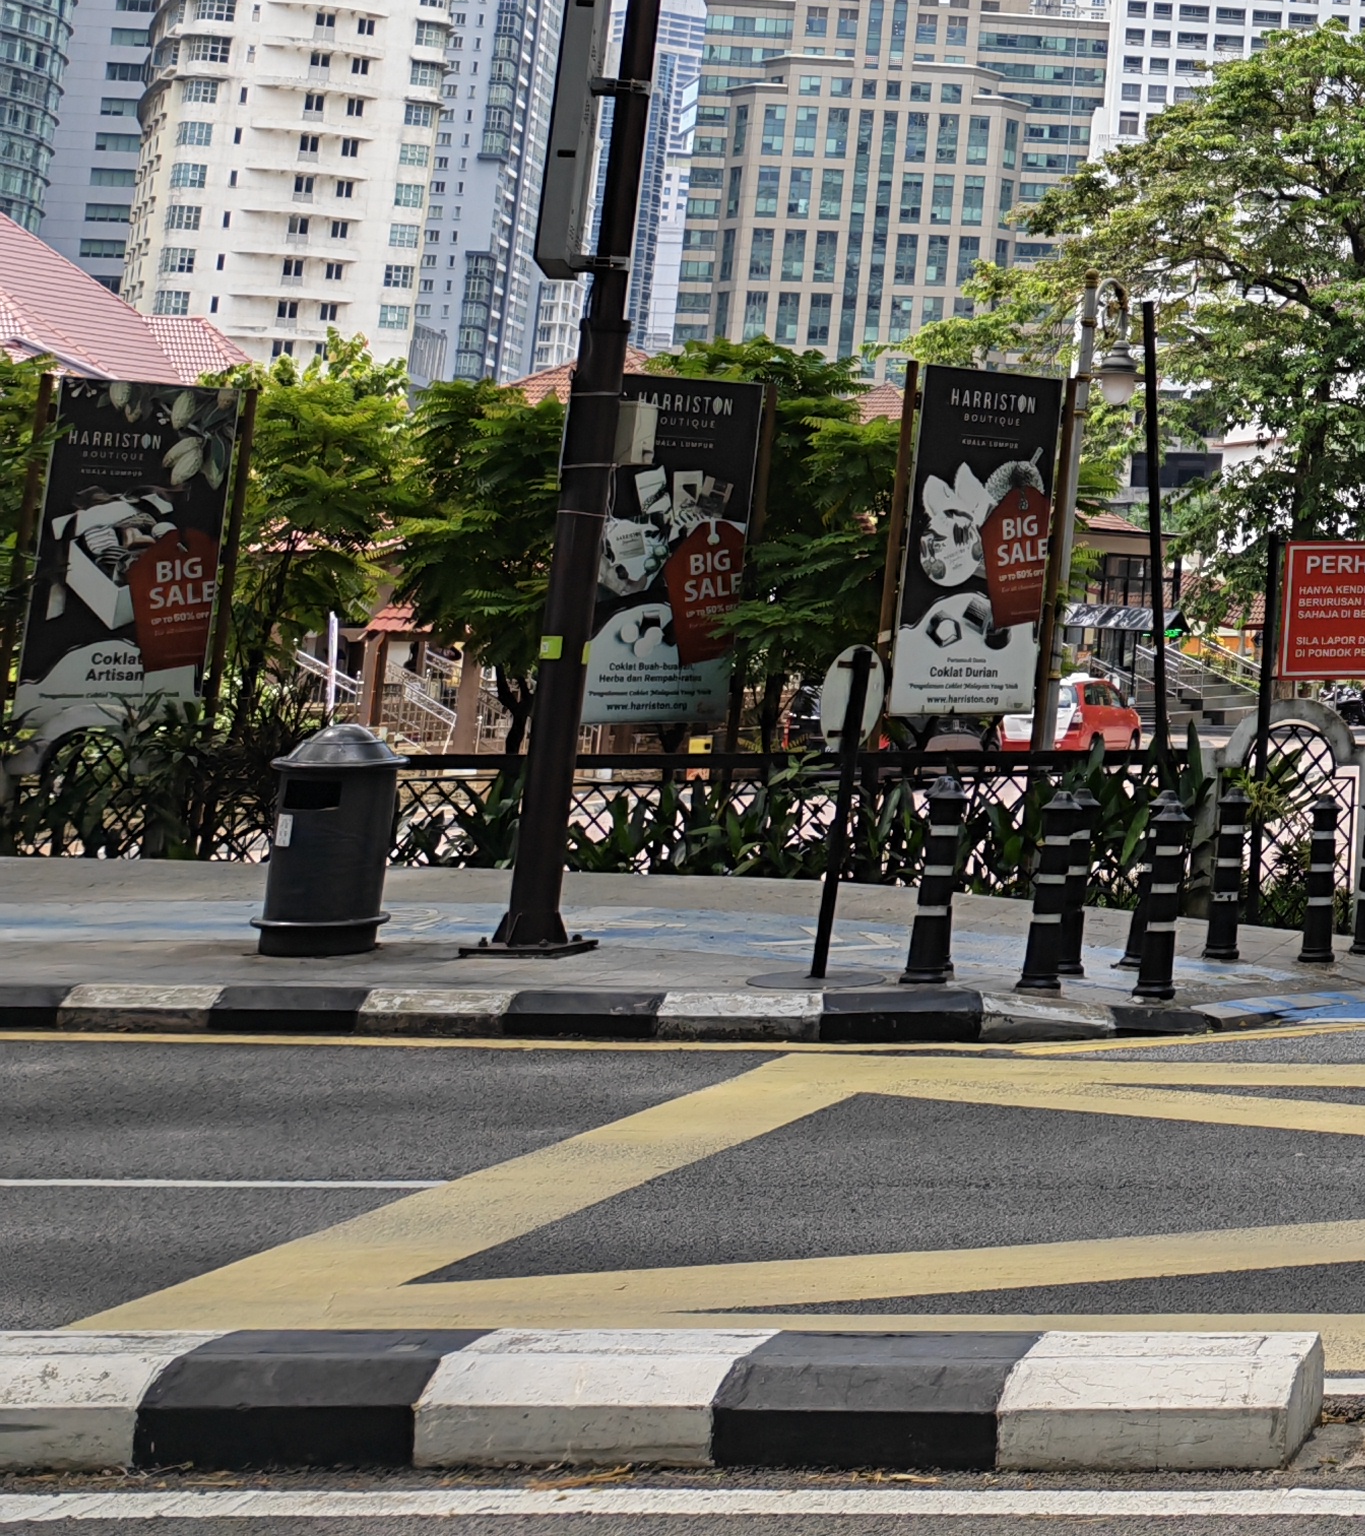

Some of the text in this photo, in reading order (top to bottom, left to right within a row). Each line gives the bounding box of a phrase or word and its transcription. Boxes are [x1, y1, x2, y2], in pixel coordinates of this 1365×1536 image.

[639, 391, 733, 416] HARRISTON
[951, 388, 1036, 414] HARRISTON
[660, 416, 715, 429] OUTIQUE
[964, 413, 1020, 427] BOUTIQUE
[68, 430, 161, 450] HARRISTON
[82, 450, 144, 462] BOUTIQUE
[1002, 514, 1038, 541] BIG
[997, 538, 1048, 567] SALE
[690, 549, 731, 576] BIG
[156, 557, 203, 583] BIG
[684, 572, 743, 603] SALE
[1299, 586, 1333, 595] HANYA
[149, 580, 216, 610] SALE
[1298, 597, 1362, 607] BERURUSAN
[1298, 610, 1338, 619] SAHAJA
[1341, 610, 1350, 618] DI
[1296, 636, 1319, 645] SILA
[1321, 636, 1356, 645] LAPOR
[91, 652, 142, 665] Coklat
[1295, 649, 1306, 657] DI
[1308, 648, 1351, 657] PONDOK
[609, 663, 636, 671] Coklat
[929, 666, 998, 678] Coklat Durian
[85, 668, 144, 682] Artisan
[599, 674, 624, 683] Herba
[627, 674, 642, 682] dan
[927, 695, 999, 705] www.harriston.org
[607, 702, 688, 712] www.harriston.org
